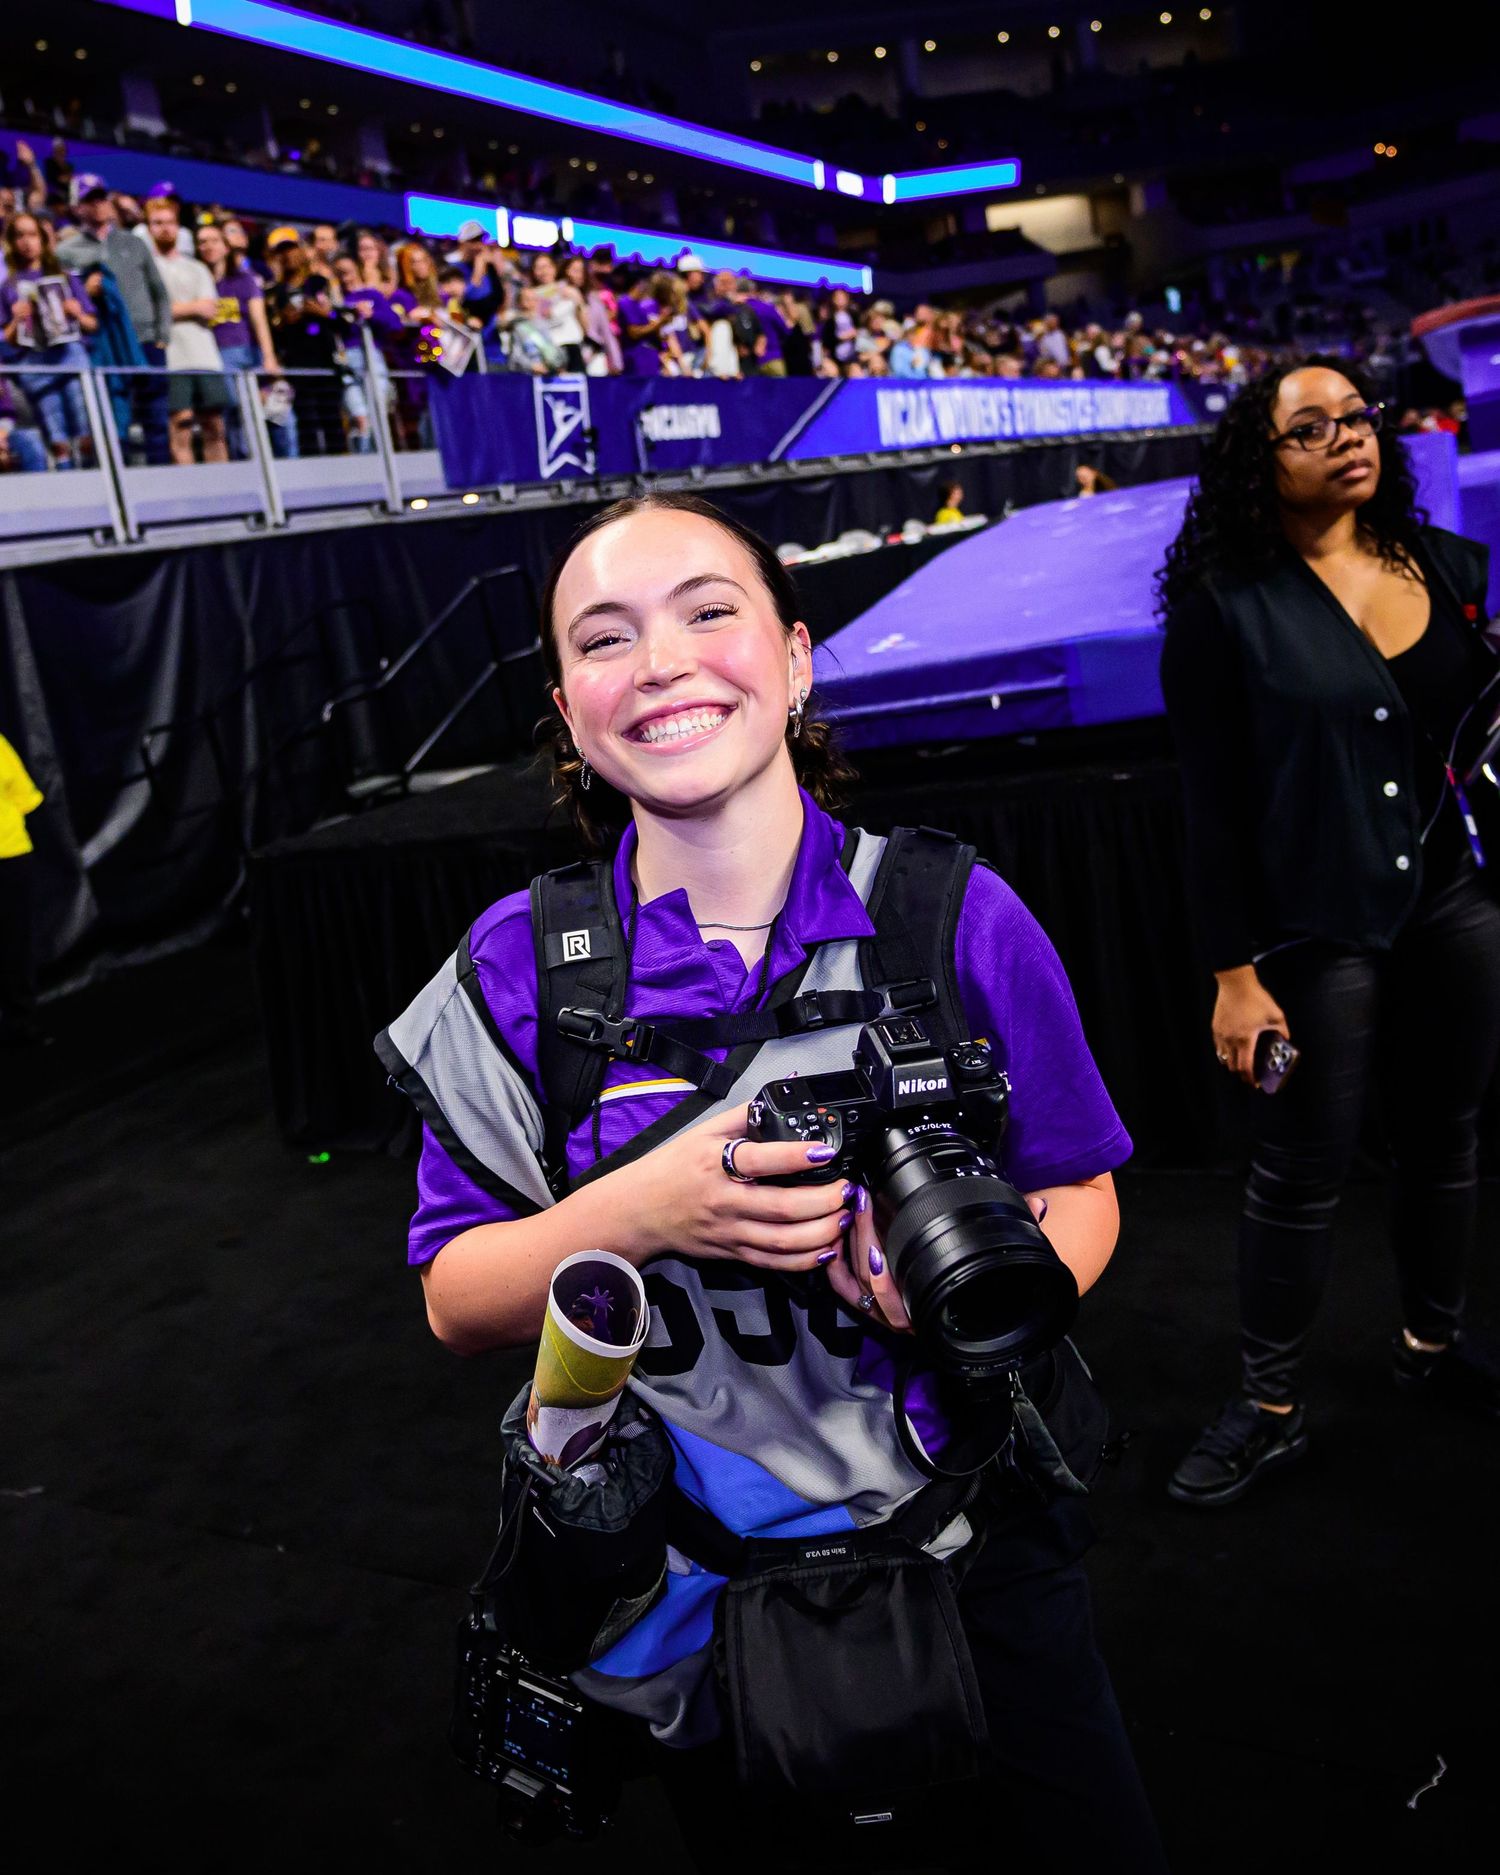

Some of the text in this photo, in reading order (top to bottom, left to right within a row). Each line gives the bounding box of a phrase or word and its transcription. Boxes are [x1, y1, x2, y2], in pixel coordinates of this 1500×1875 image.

[898, 1078, 947, 1095] Nikon
[914, 1122, 952, 1133] 24-70/2.8
[831, 1547, 846, 1555] Skin
